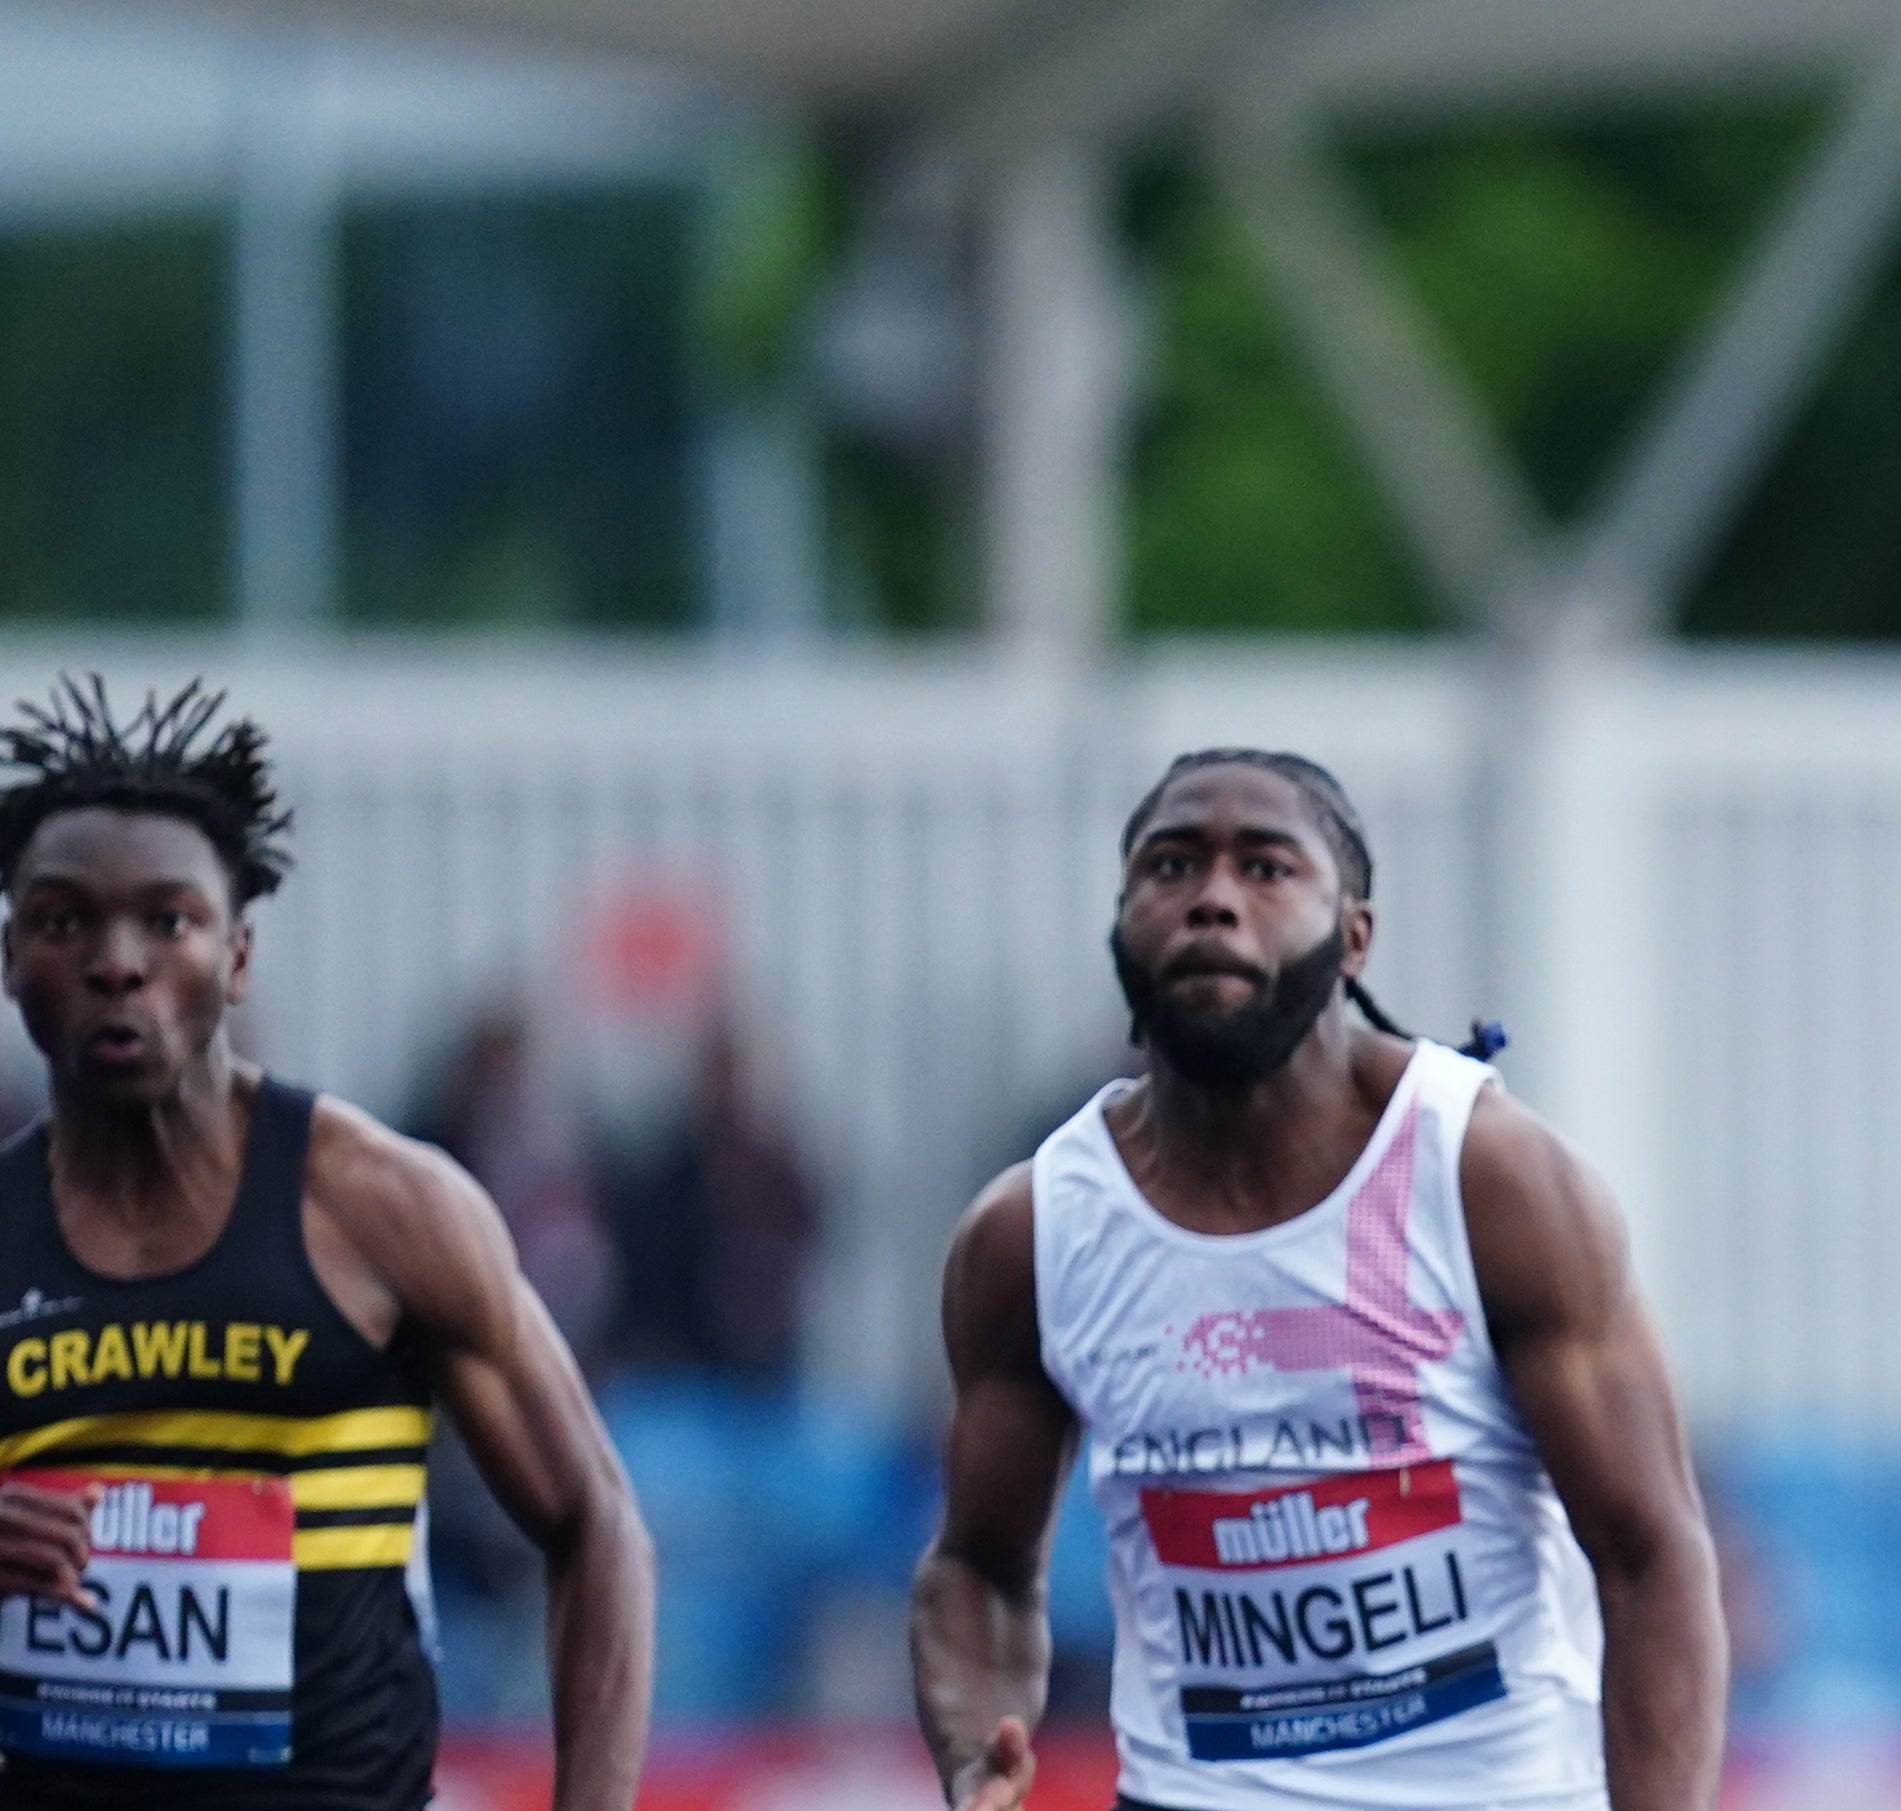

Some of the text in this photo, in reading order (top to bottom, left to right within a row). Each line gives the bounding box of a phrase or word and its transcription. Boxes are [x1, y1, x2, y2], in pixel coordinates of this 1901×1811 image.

[6, 1319, 311, 1398] CRAWLEY
[1113, 1411, 1414, 1472] ENGLAND
[90, 1481, 207, 1556] üller
[1211, 1490, 1370, 1565] müller
[27, 1579, 231, 1663] ESAN
[1173, 1549, 1469, 1668] MINGELI
